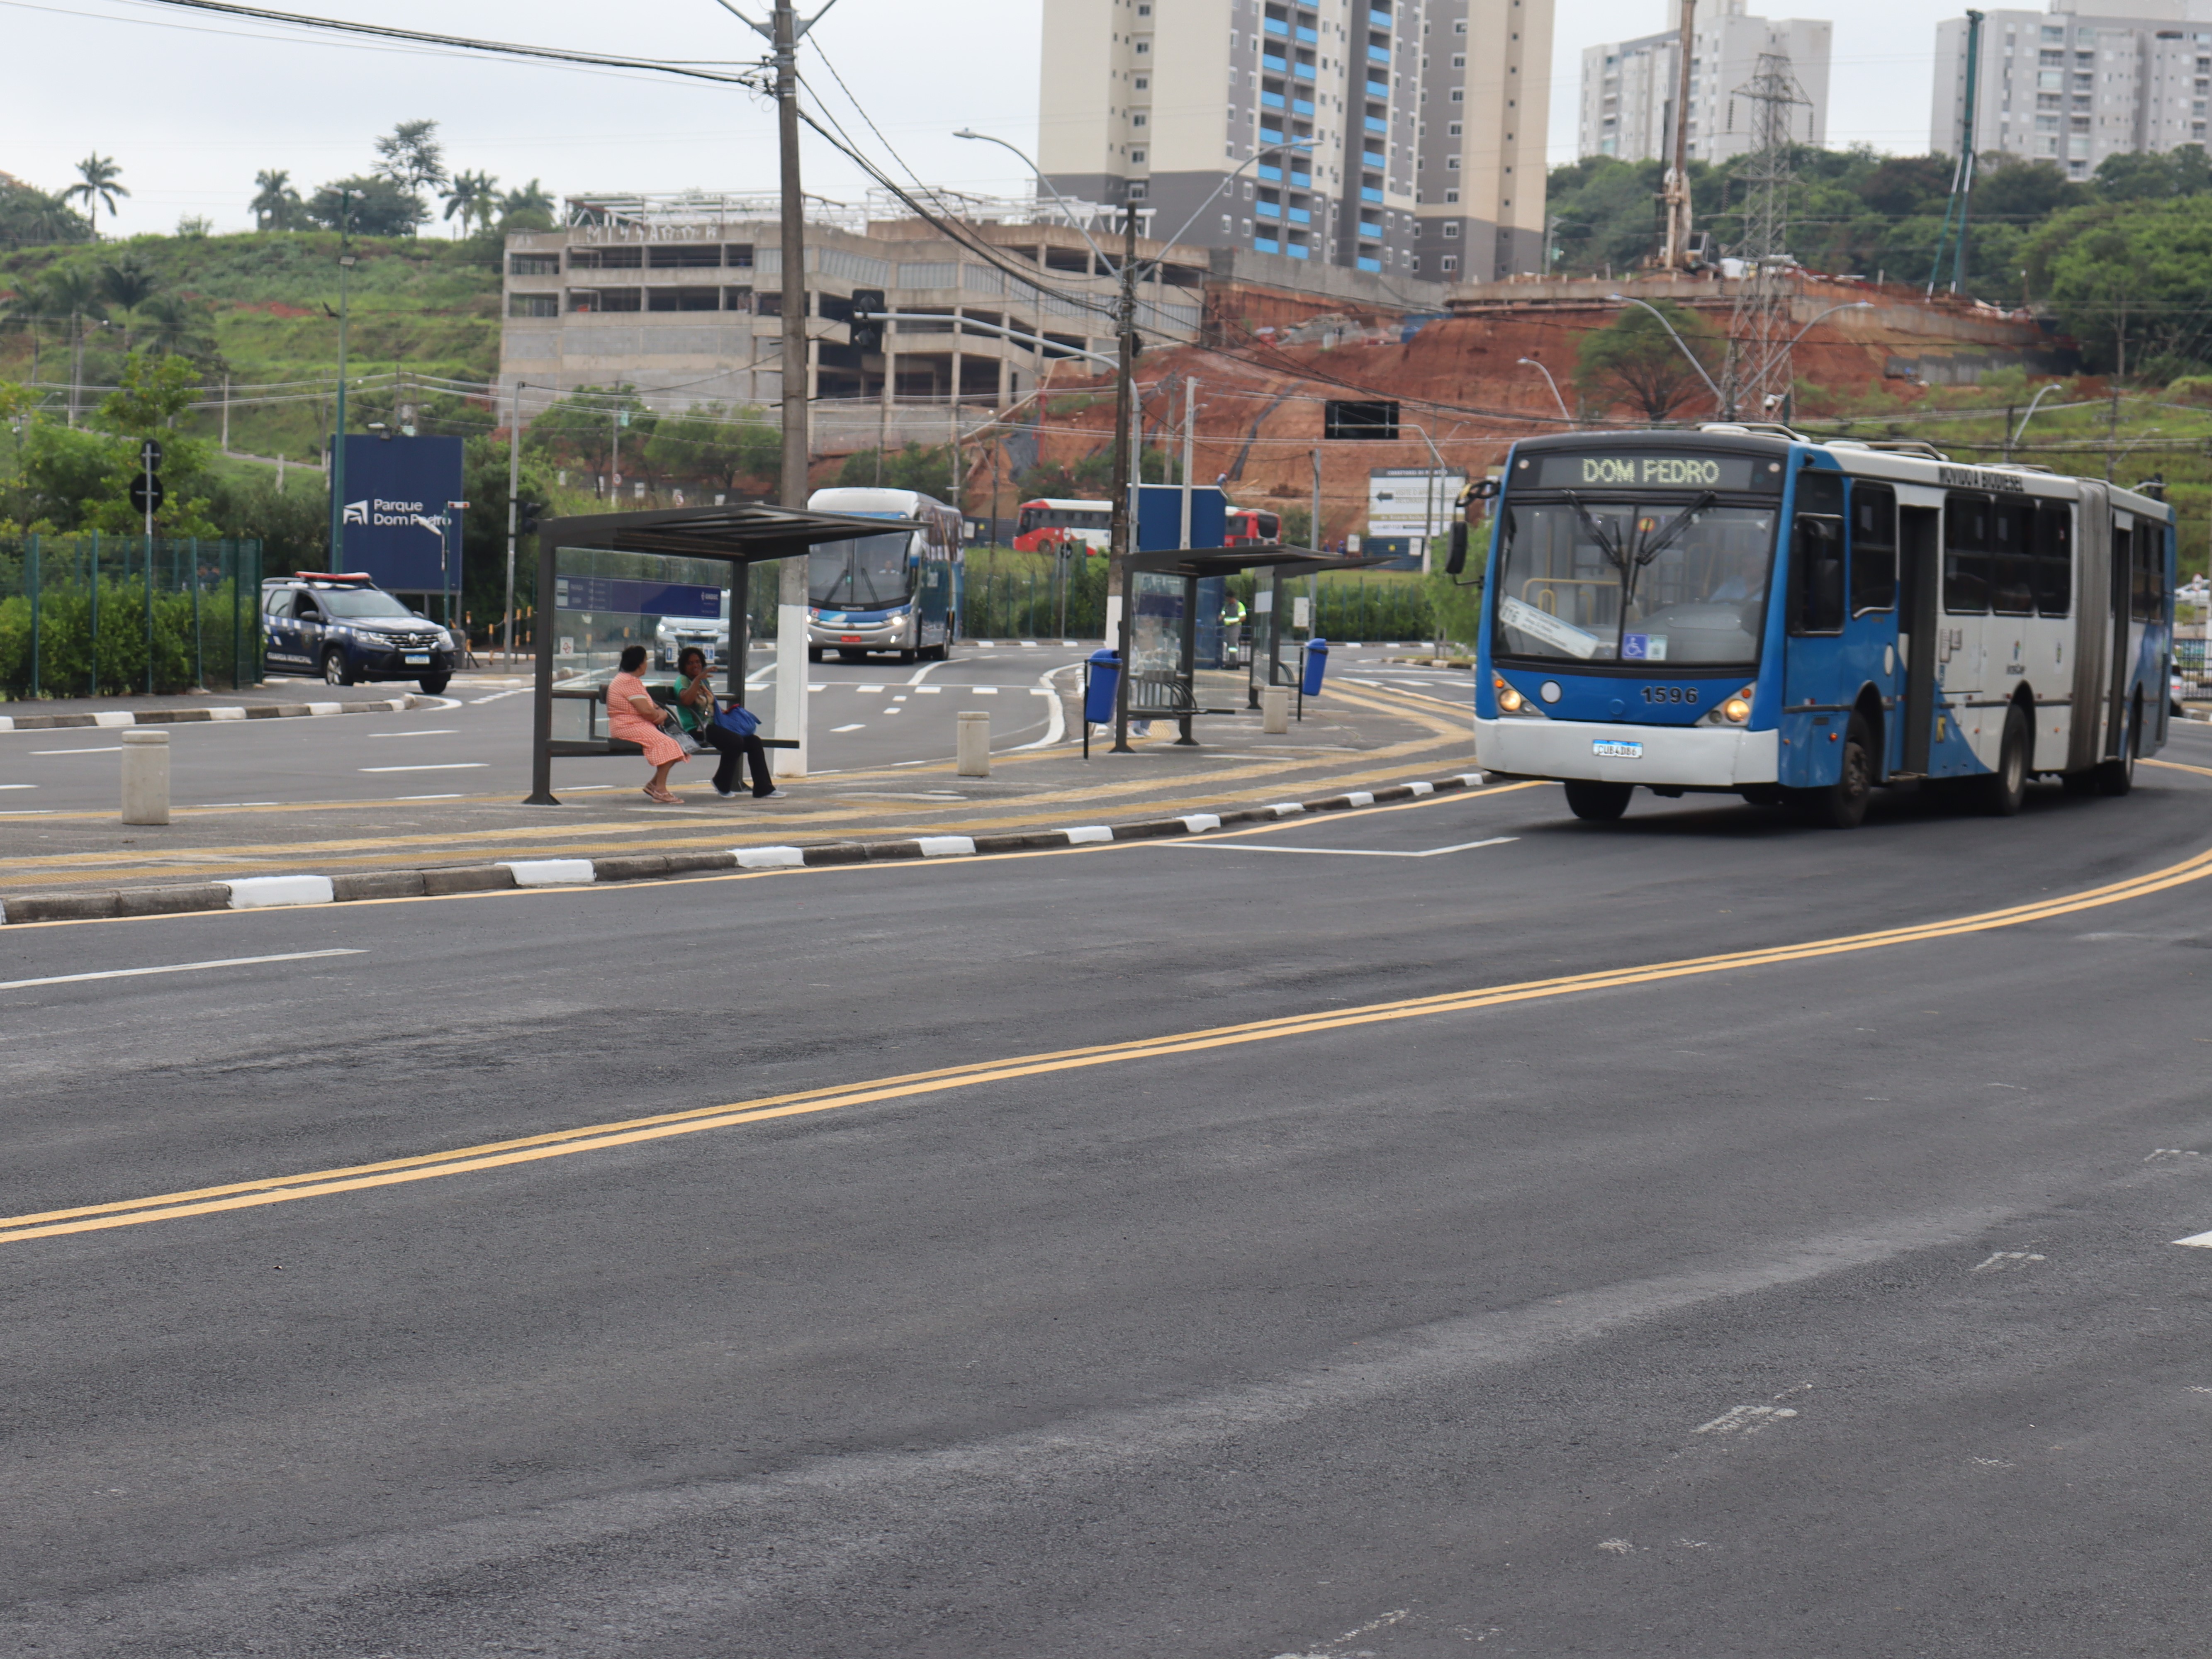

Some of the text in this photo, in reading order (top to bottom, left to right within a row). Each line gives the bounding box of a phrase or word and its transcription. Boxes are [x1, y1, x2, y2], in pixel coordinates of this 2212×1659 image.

[1582, 458, 1720, 484] DOM PEDRO
[374, 499, 423, 513] Parque
[374, 513, 409, 525] Dom
[1641, 685, 1699, 705] 1596
